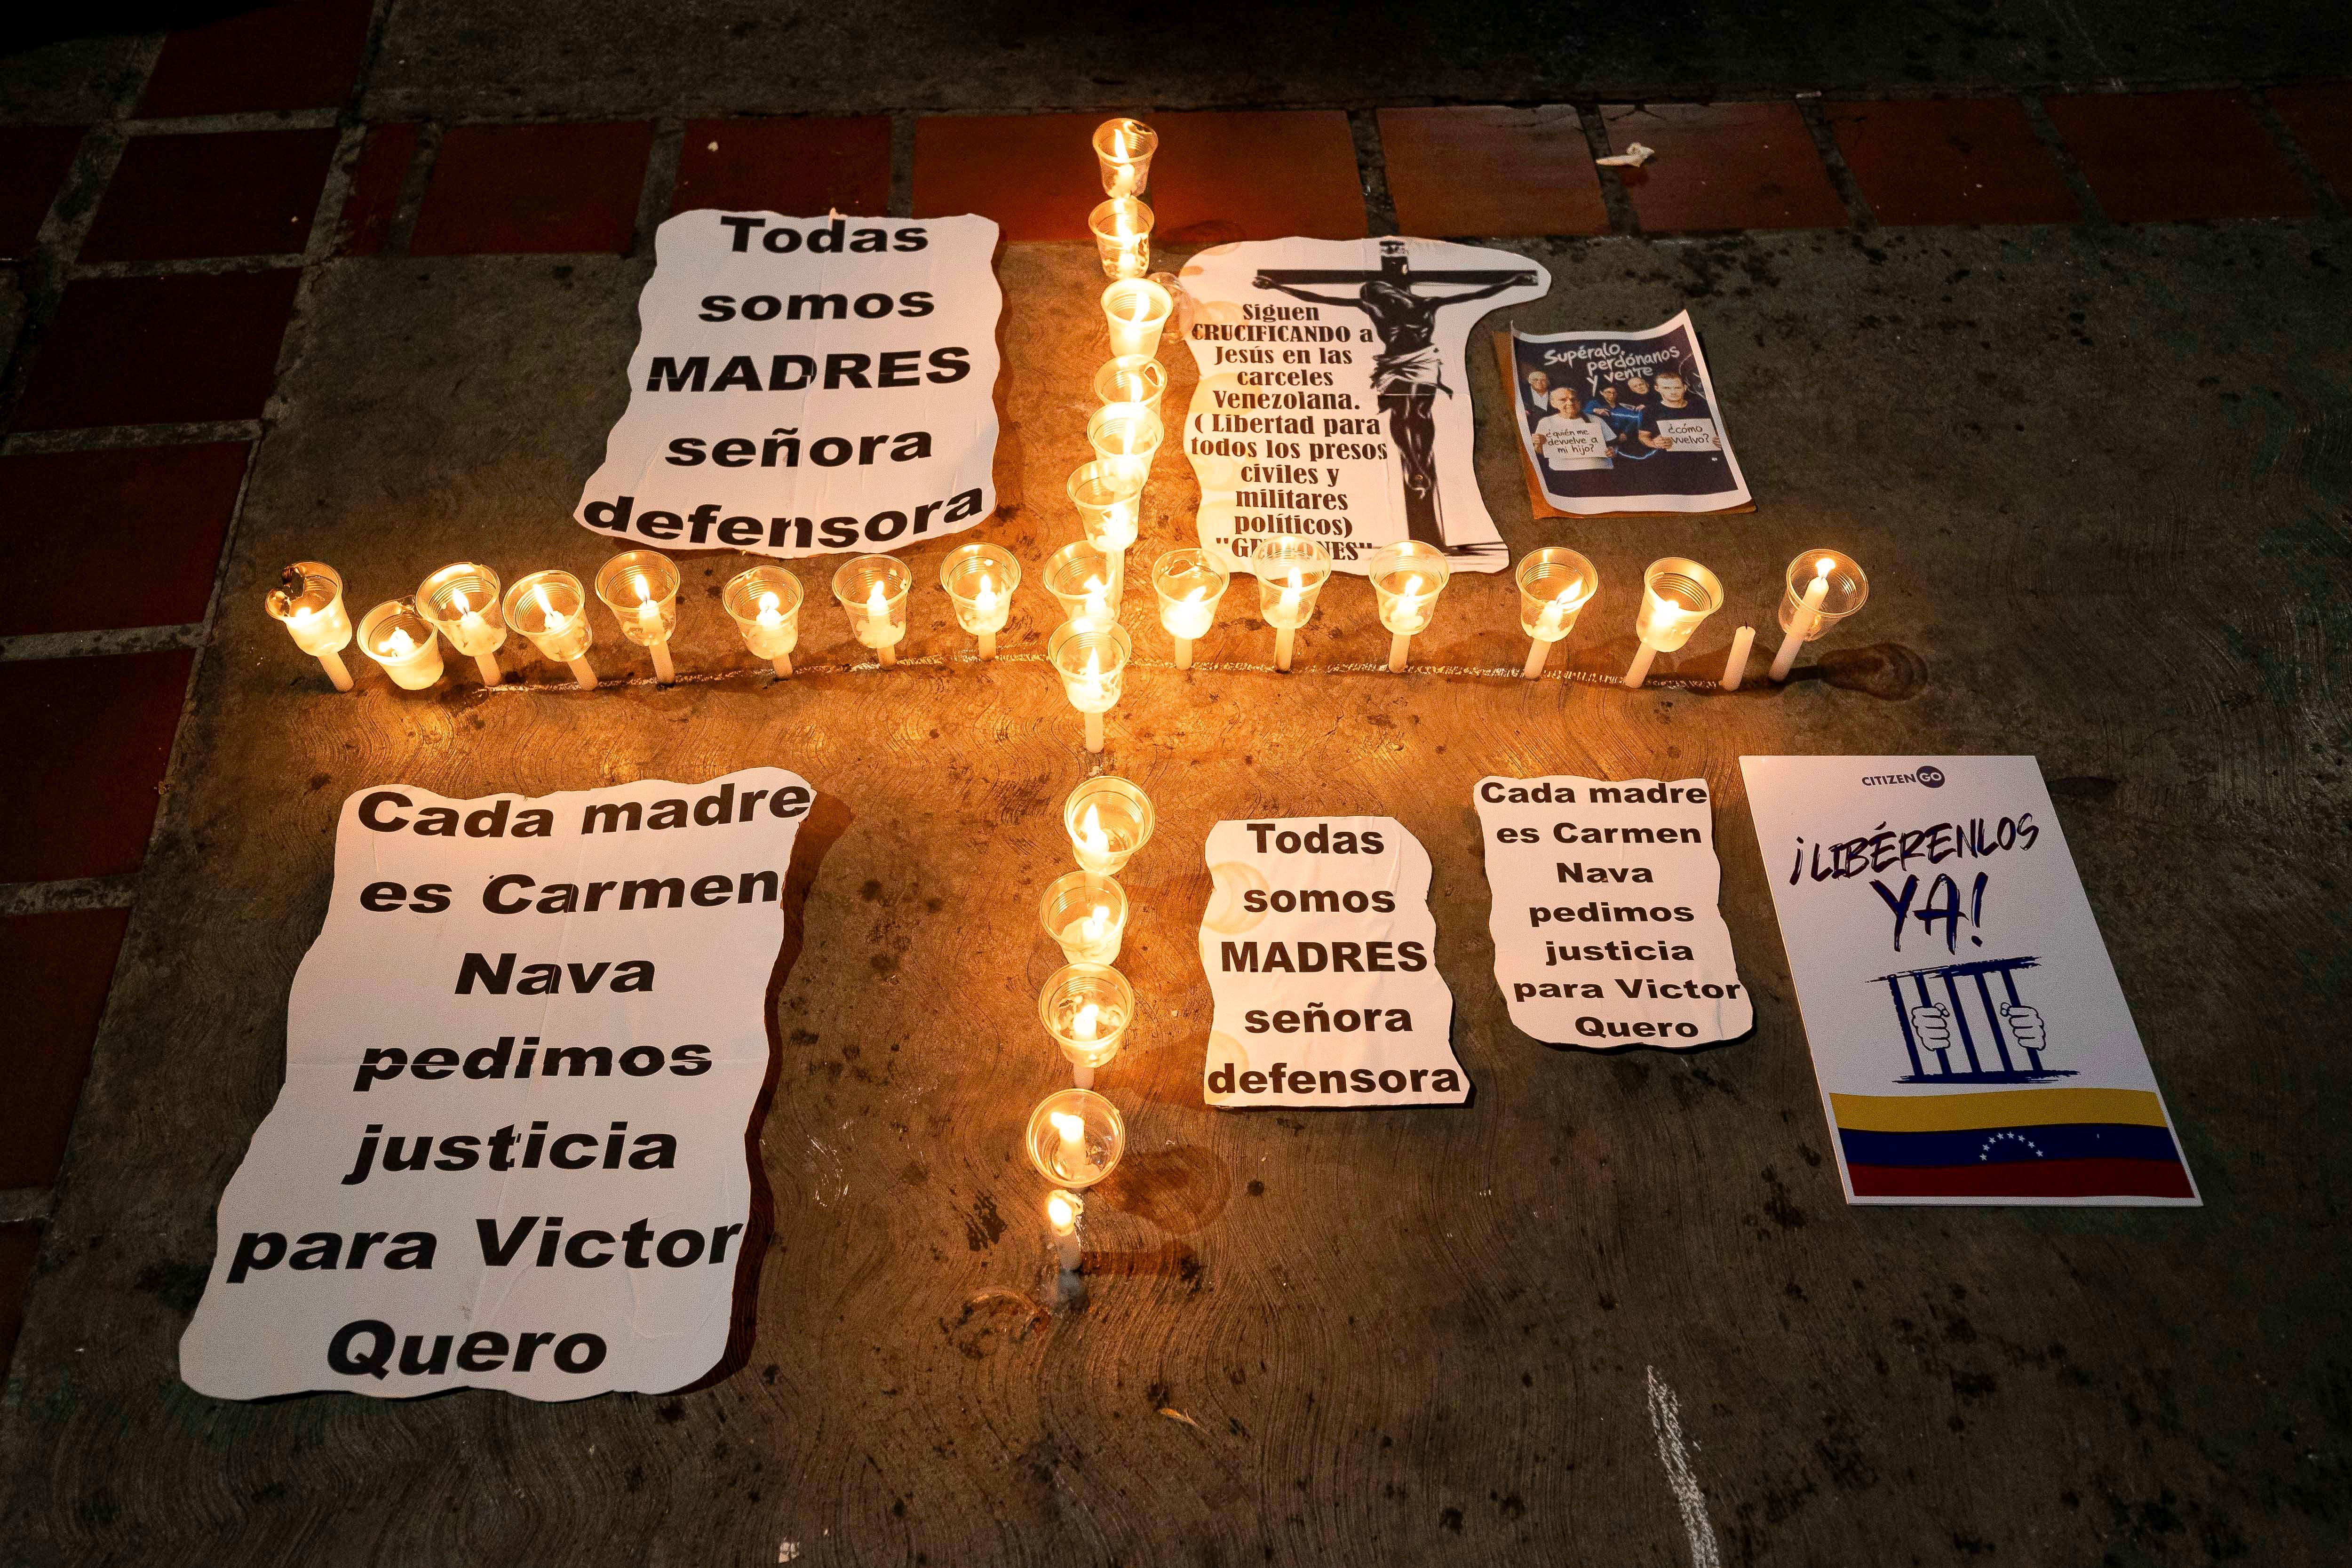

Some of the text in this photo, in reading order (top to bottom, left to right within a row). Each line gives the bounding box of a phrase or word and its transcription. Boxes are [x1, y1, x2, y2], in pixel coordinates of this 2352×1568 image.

[721, 215, 928, 253] Todas
[699, 292, 934, 322] somos
[1243, 304, 1319, 322] Siguen
[1192, 324, 1373, 342] CRUCIFICANDO a
[1216, 347, 1352, 365] Jesús en las
[1587, 346, 1680, 376] perdónanos
[646, 347, 970, 392] MADRES
[1238, 370, 1333, 385] carceles
[1587, 367, 1653, 397] y vente
[1213, 391, 1359, 409] Venezolana.
[1324, 419, 1380, 437] para
[1668, 424, 1703, 434] ¿cómo
[1671, 434, 1709, 444] vuelvo?
[665, 428, 931, 467] señora
[1192, 438, 1387, 462] todos los presos
[1548, 437, 1587, 446] devuelve
[1572, 445, 1594, 455] hijo?
[1241, 465, 1339, 487] civiles y
[1236, 490, 1348, 510] militares
[584, 487, 983, 548] defensora
[1235, 515, 1352, 538] políticos)
[1481, 782, 1707, 804] Cada madre
[358, 784, 811, 838] Cada madre
[1247, 824, 1384, 854] Todas
[1497, 823, 1701, 843] es Carmen
[1789, 812, 2040, 885] ¡LIBÉRENLOS
[1557, 863, 1653, 883] Nava
[360, 871, 778, 914] es Carmen
[1244, 890, 1395, 913] somos
[1530, 902, 1694, 927] pedimos
[1869, 872, 1988, 955] YA!
[1222, 941, 1427, 972] MADRES
[1546, 941, 1694, 966] justicia
[455, 953, 655, 995] Nava
[1514, 979, 1740, 1002] para Victor
[1245, 1003, 1413, 1033] señora
[1575, 1017, 1698, 1038] Quero
[353, 1037, 712, 1091] pedimos
[1208, 1063, 1461, 1094] defensora
[341, 1121, 676, 1185] justicia
[226, 1216, 743, 1283] para Victor
[327, 1320, 607, 1380] Quero
